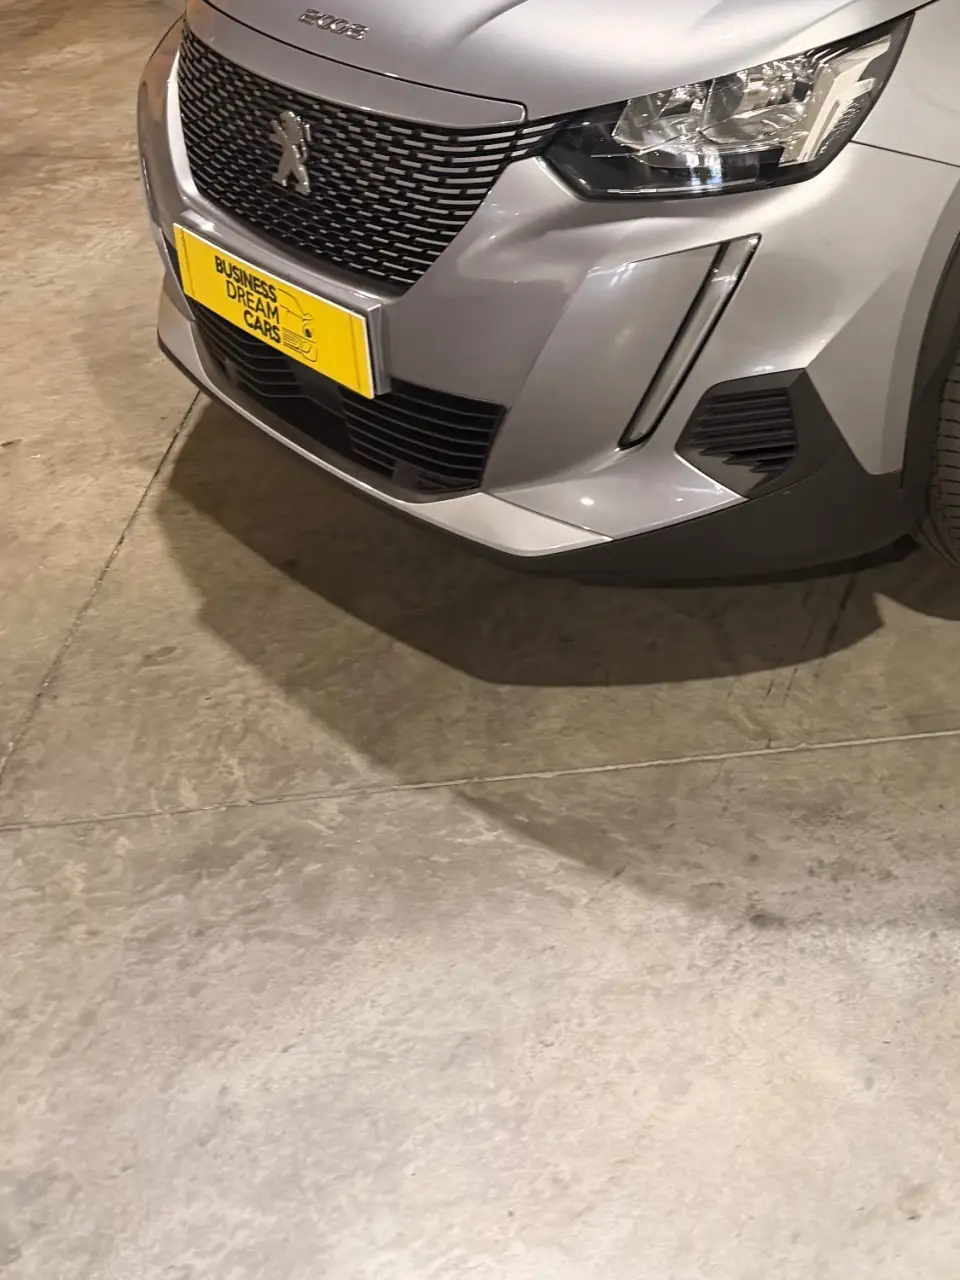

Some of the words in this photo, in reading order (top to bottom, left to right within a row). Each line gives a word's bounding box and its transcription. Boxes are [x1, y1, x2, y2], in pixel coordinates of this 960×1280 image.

[214, 255, 278, 304] BUSINESS
[225, 280, 280, 325] DREAM
[243, 310, 281, 344] CARS
